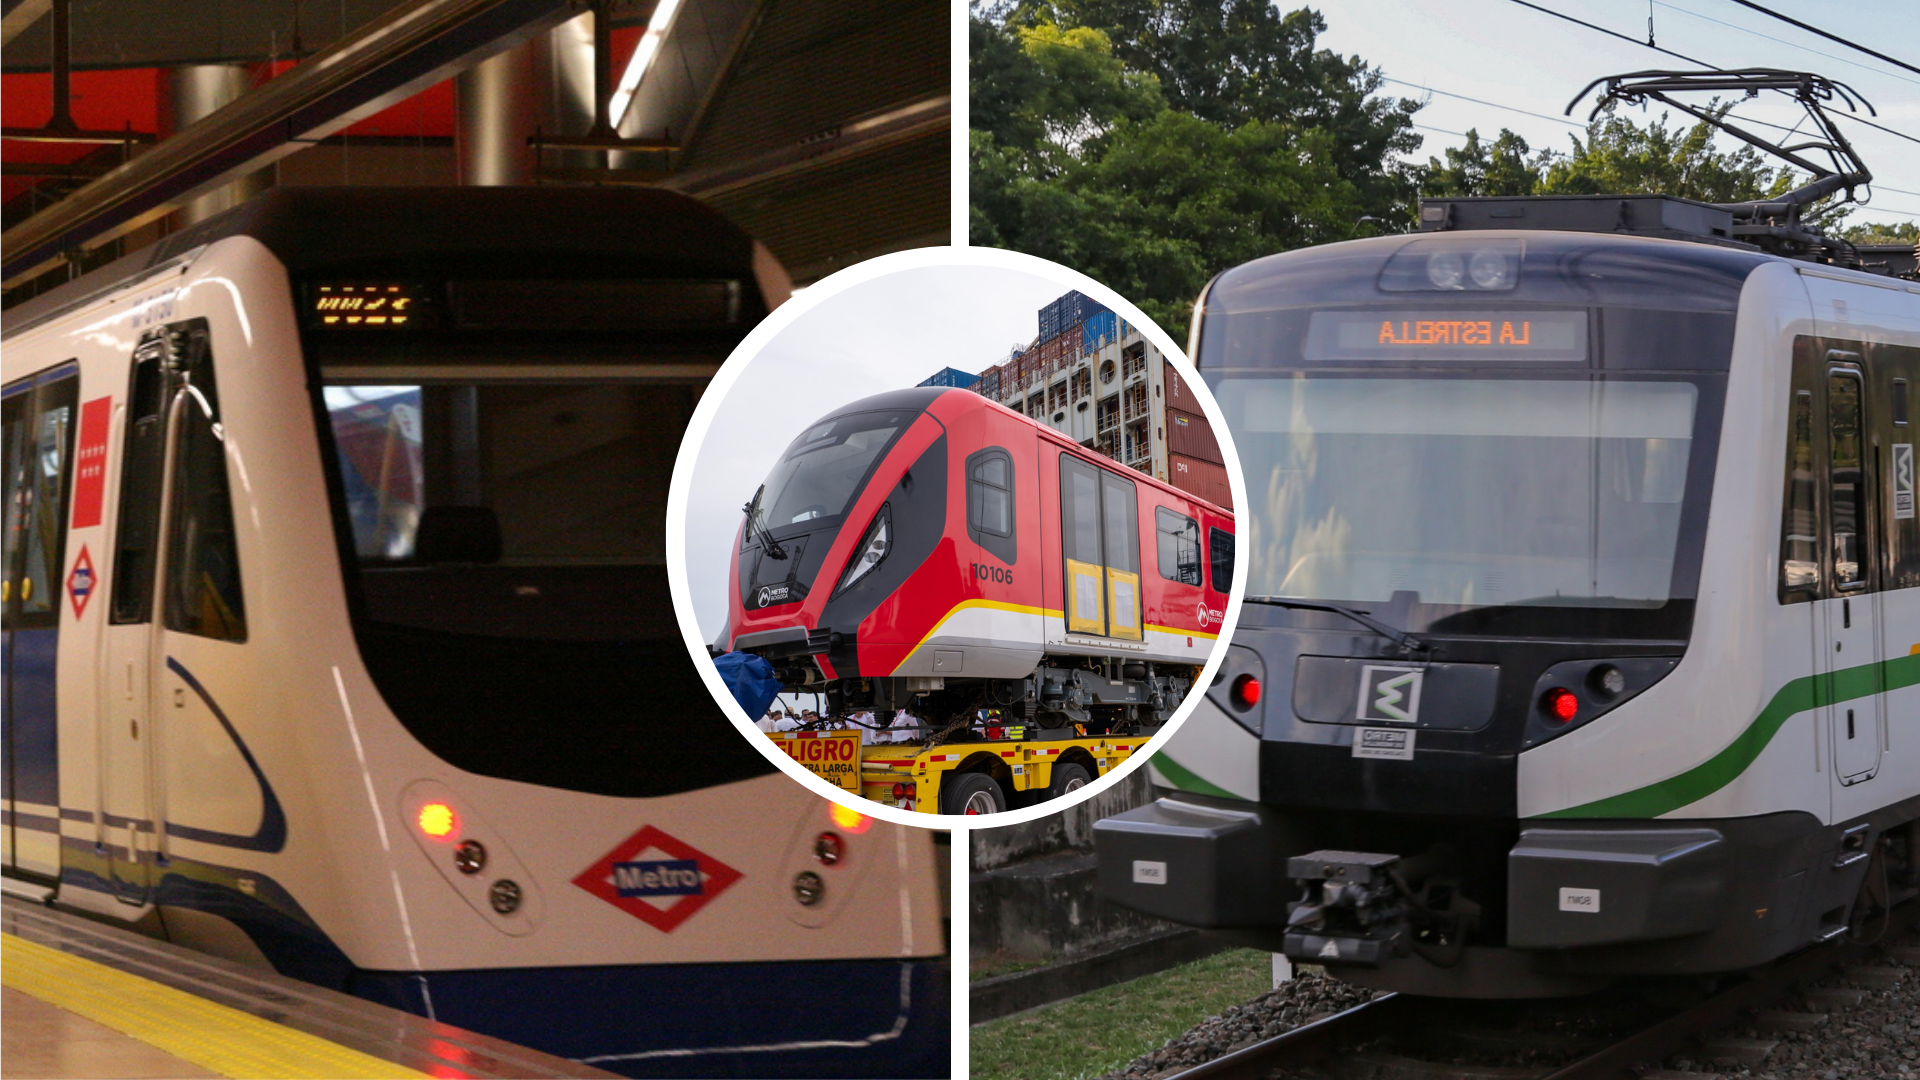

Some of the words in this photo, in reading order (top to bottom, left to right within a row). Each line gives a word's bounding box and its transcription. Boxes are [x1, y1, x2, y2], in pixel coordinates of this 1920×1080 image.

[972, 563, 1013, 585] 10106
[771, 587, 788, 595] METRO
[1209, 609, 1223, 617] METRO
[823, 764, 854, 773] LARGA
[615, 866, 698, 889] Metro
